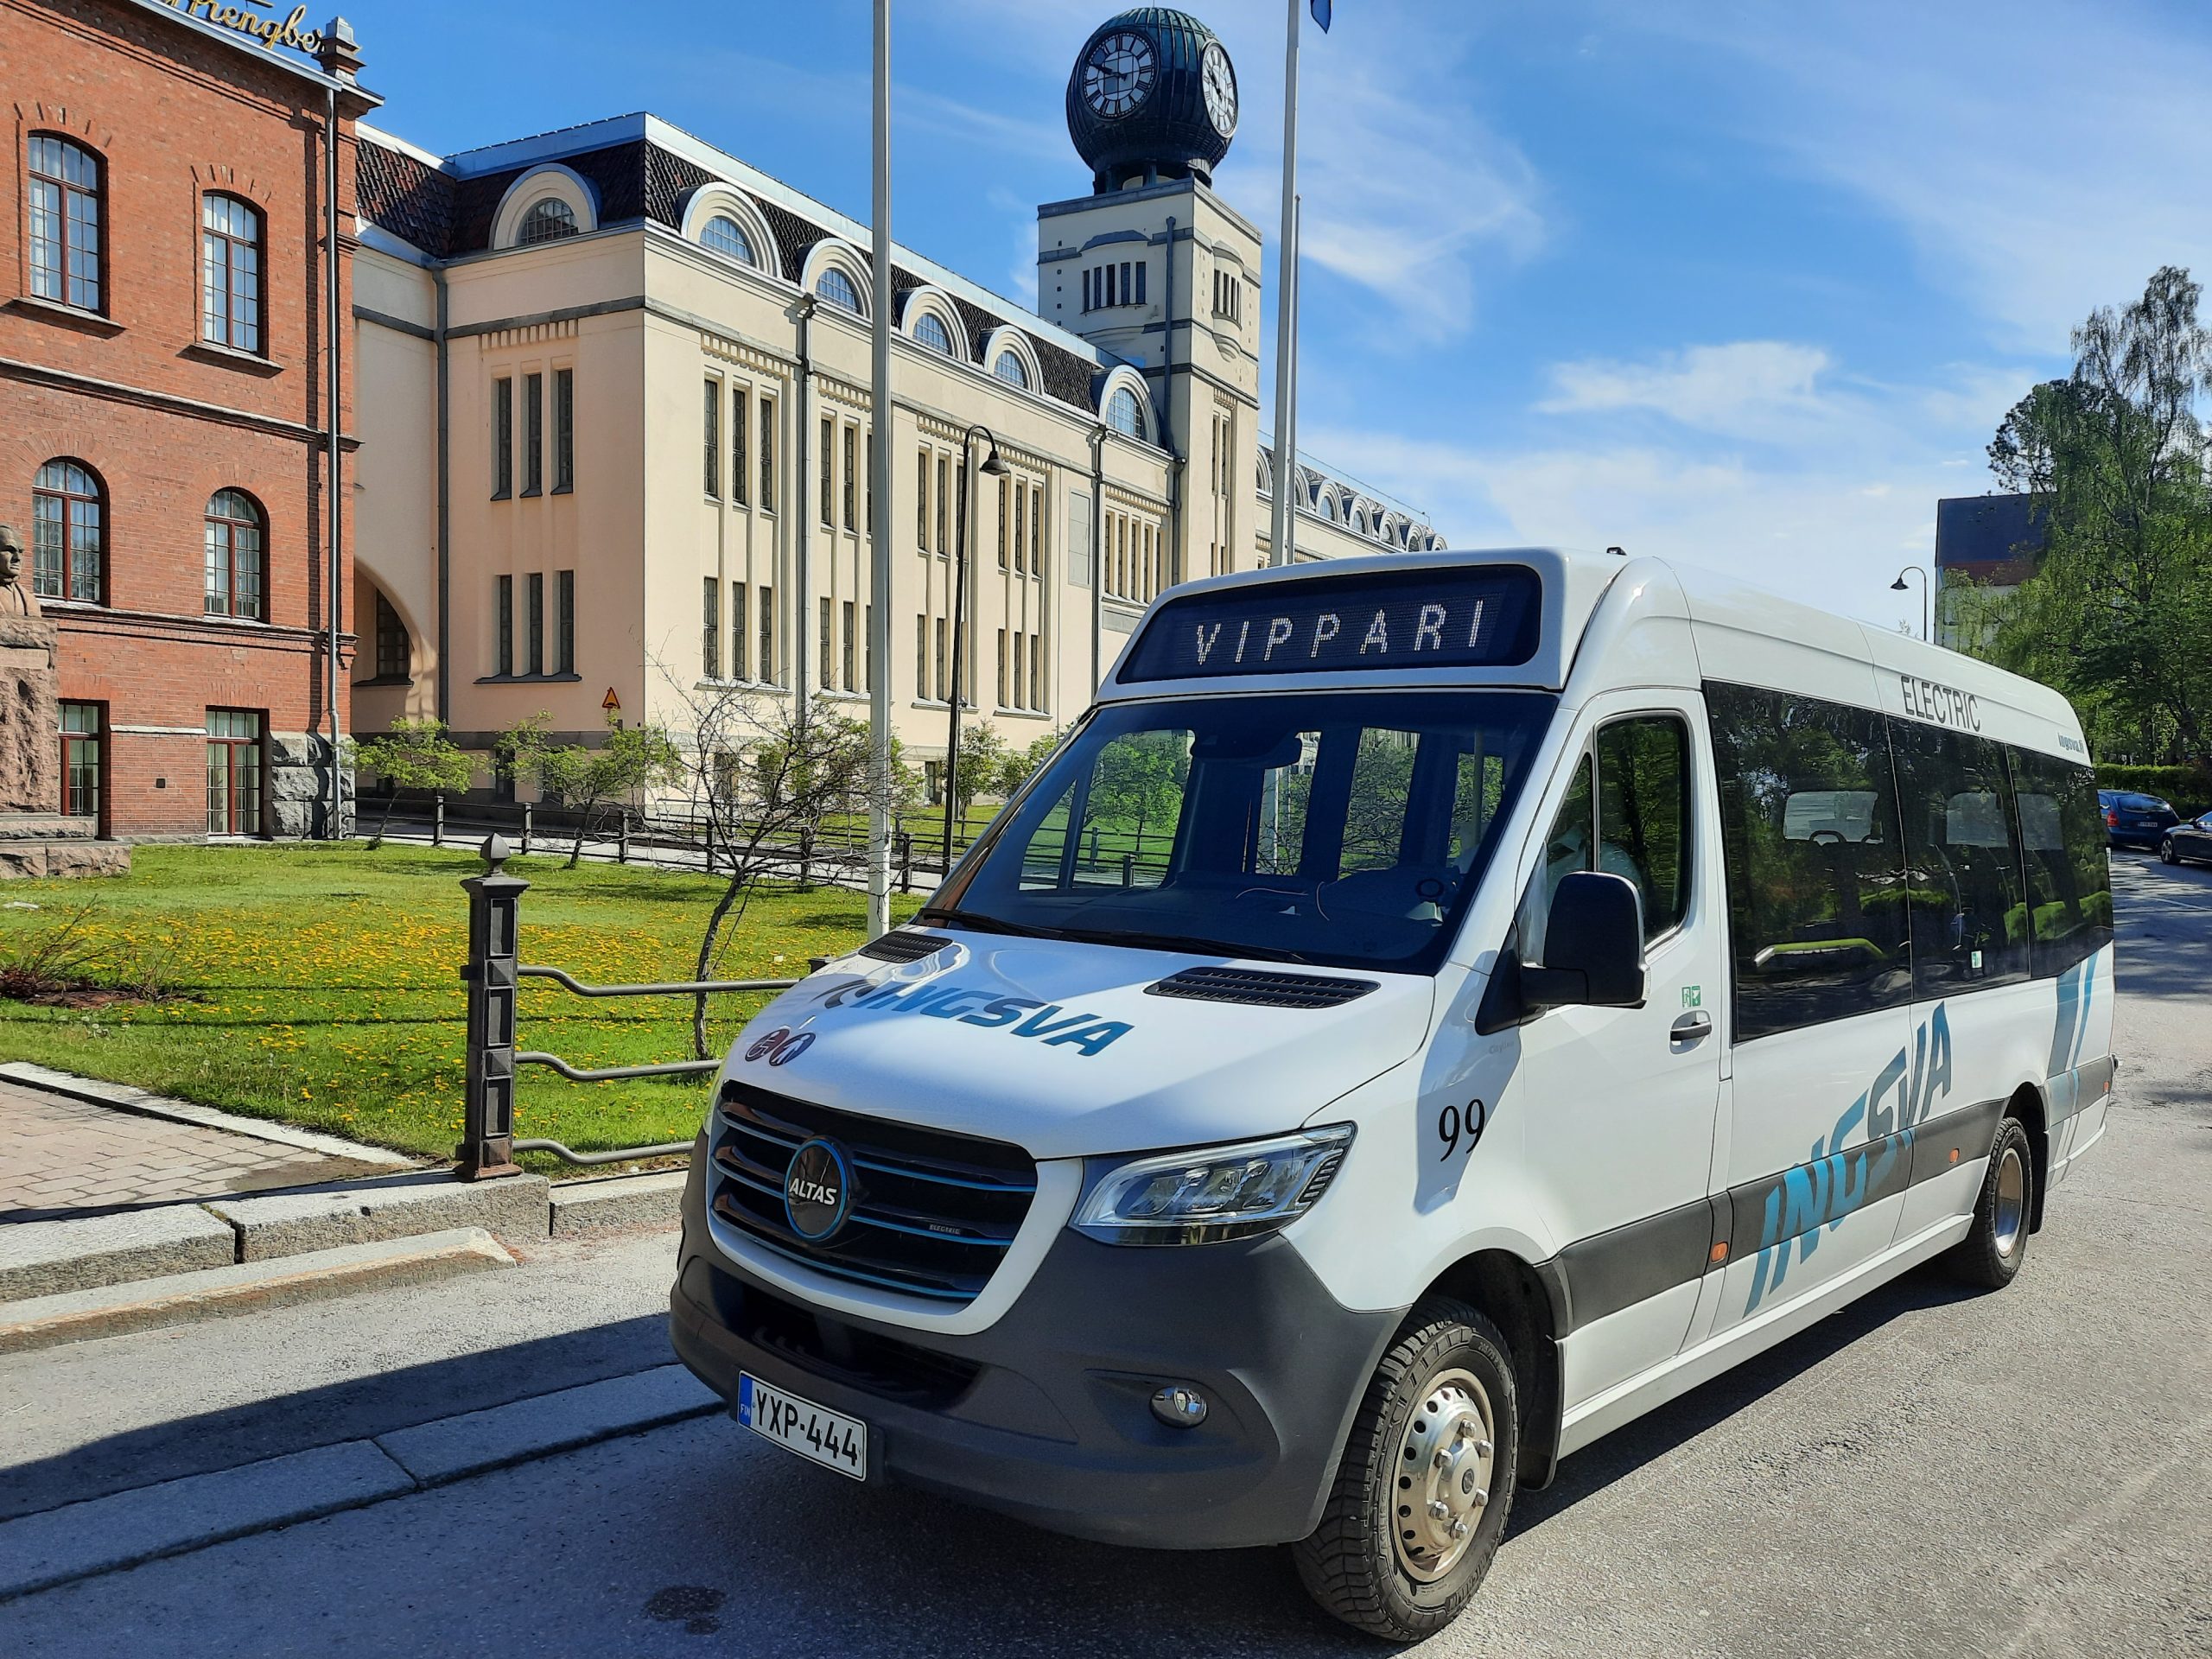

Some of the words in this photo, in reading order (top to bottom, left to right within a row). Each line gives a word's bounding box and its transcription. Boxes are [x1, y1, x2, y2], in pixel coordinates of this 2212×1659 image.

[1196, 600, 1483, 665] VIPPARI
[1901, 676, 1980, 732] ELECTRIC
[849, 983, 1135, 1056] INGSVA
[1439, 1099, 1485, 1162] 99
[1743, 1001, 1952, 1319] INGSVA
[790, 1178, 837, 1205] ALTAS
[741, 1403, 751, 1417] FIN
[756, 1389, 858, 1466] YXP-444
